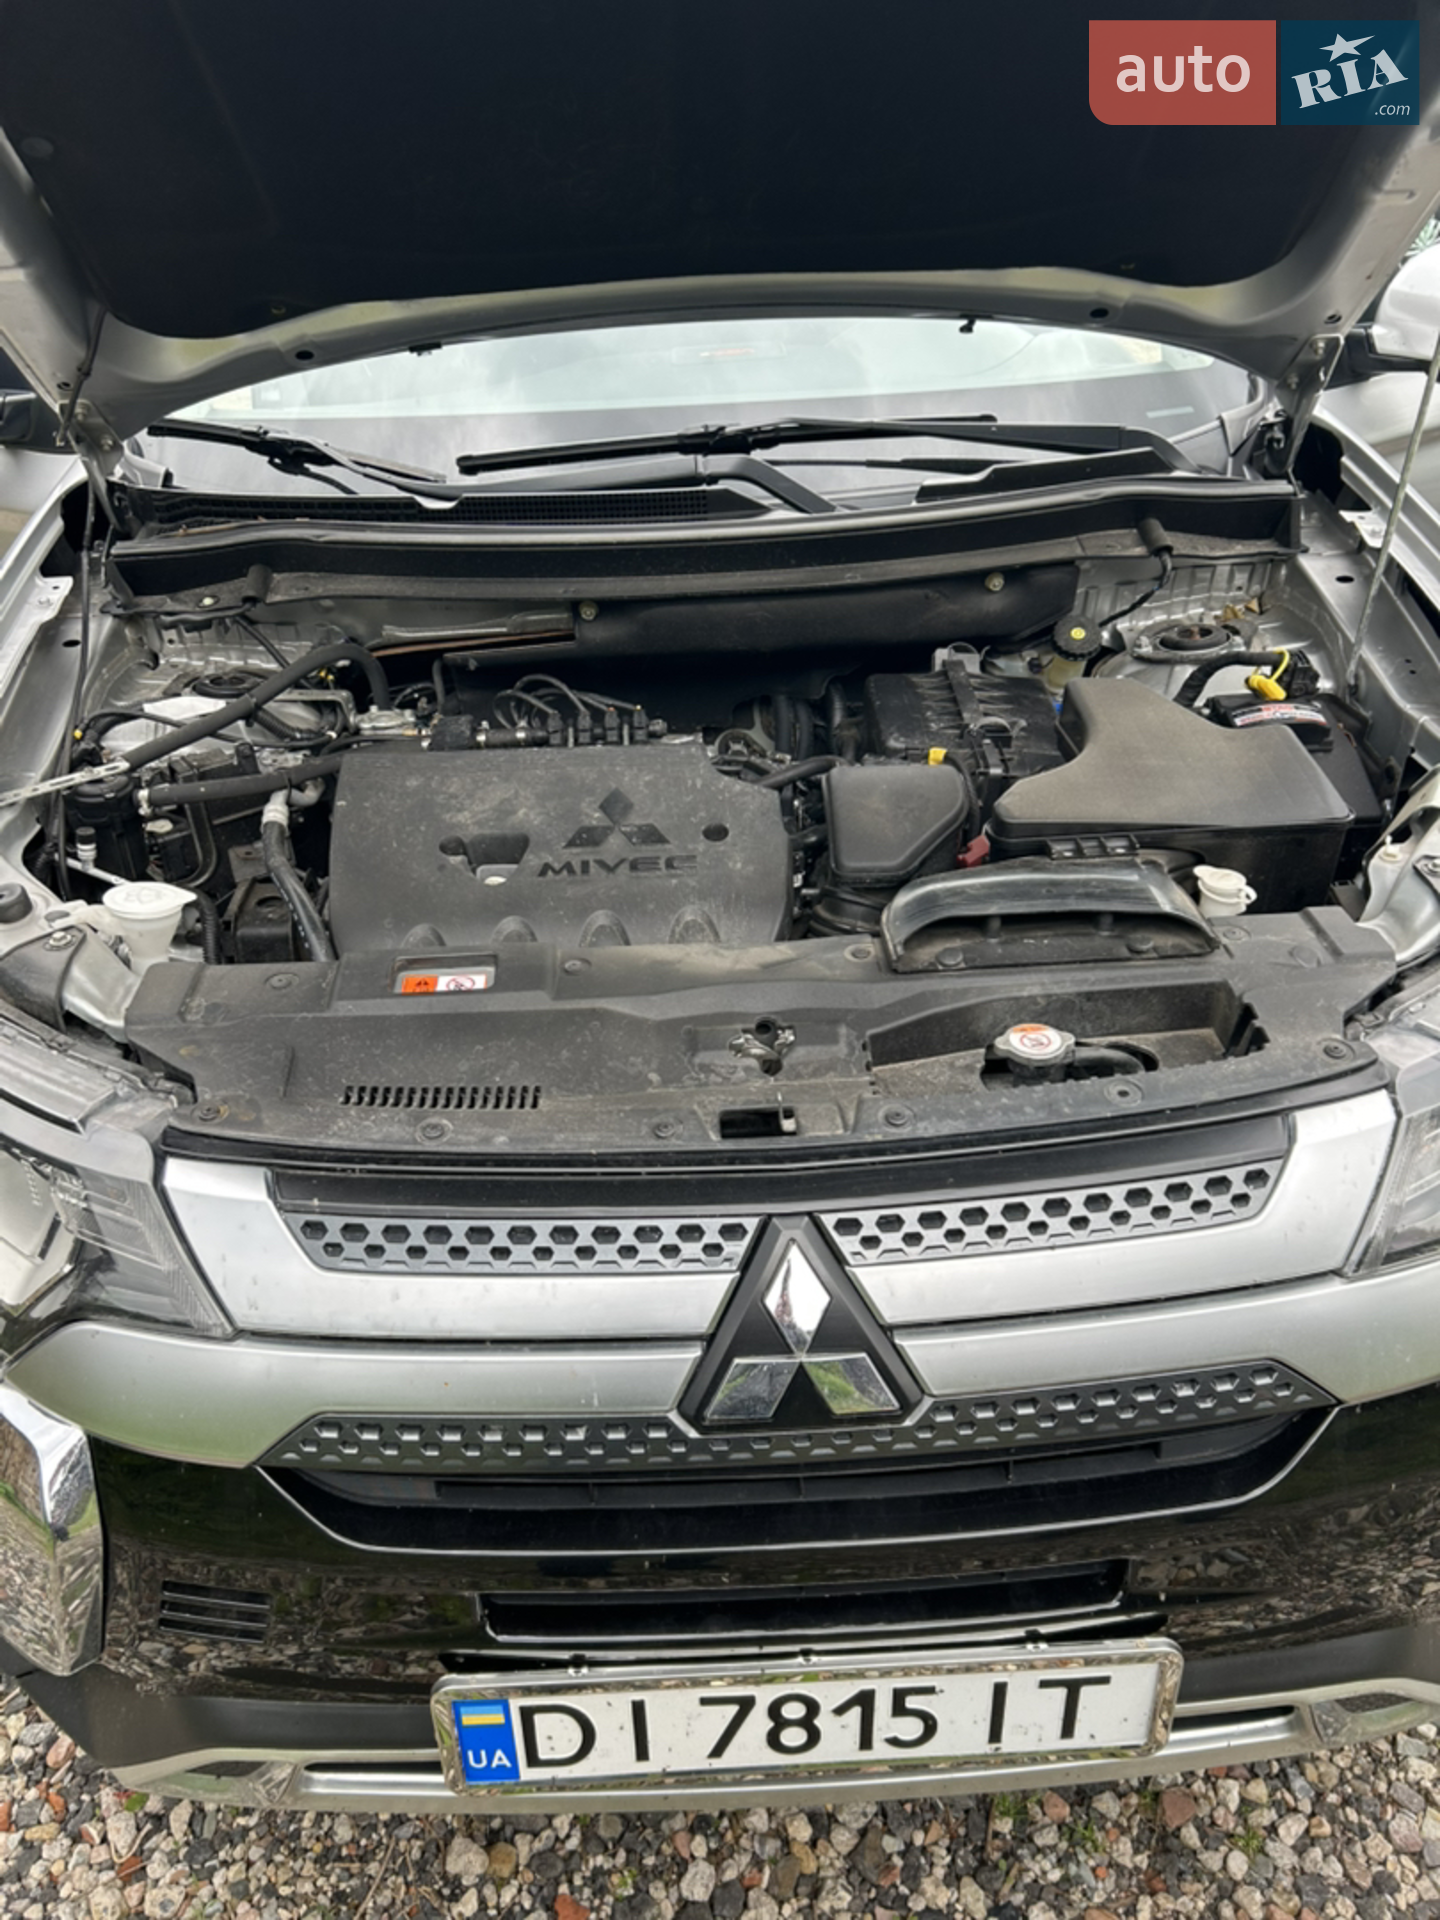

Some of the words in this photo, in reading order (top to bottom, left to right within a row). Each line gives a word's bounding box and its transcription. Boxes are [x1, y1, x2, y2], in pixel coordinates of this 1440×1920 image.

[537, 854, 698, 878] MIVEC
[518, 1699, 650, 1768] DI
[699, 1685, 938, 1759] 7815
[988, 1675, 1112, 1745] IT
[466, 1749, 512, 1769] UA
